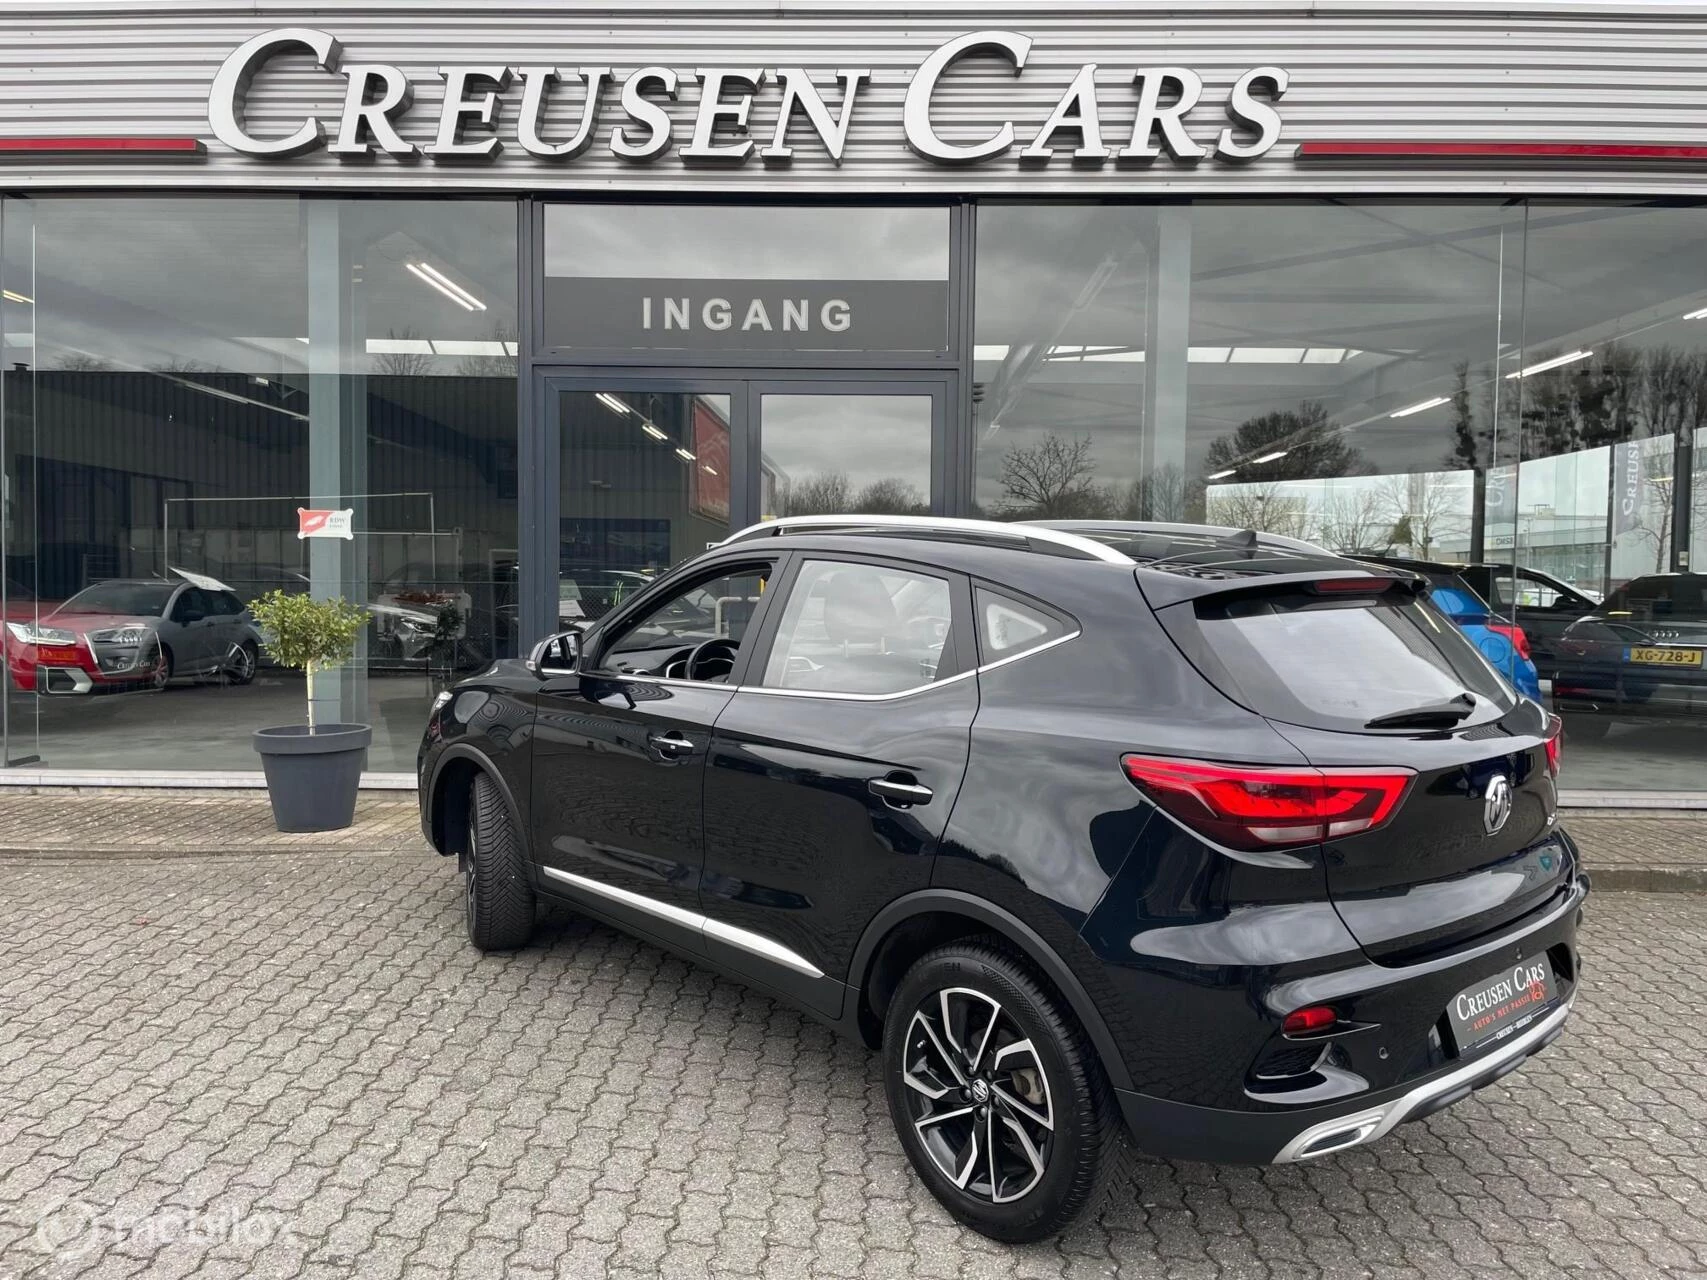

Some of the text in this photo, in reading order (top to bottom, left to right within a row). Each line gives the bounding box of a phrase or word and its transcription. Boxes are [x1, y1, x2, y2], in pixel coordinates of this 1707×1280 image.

[207, 27, 1290, 166] CREUSEN CARS
[642, 297, 851, 332] INGANG
[1635, 650, 1696, 663] XG-728-J
[1456, 963, 1545, 1021] CREUSEN CARS
[1473, 1013, 1496, 1031] AUTO'S
